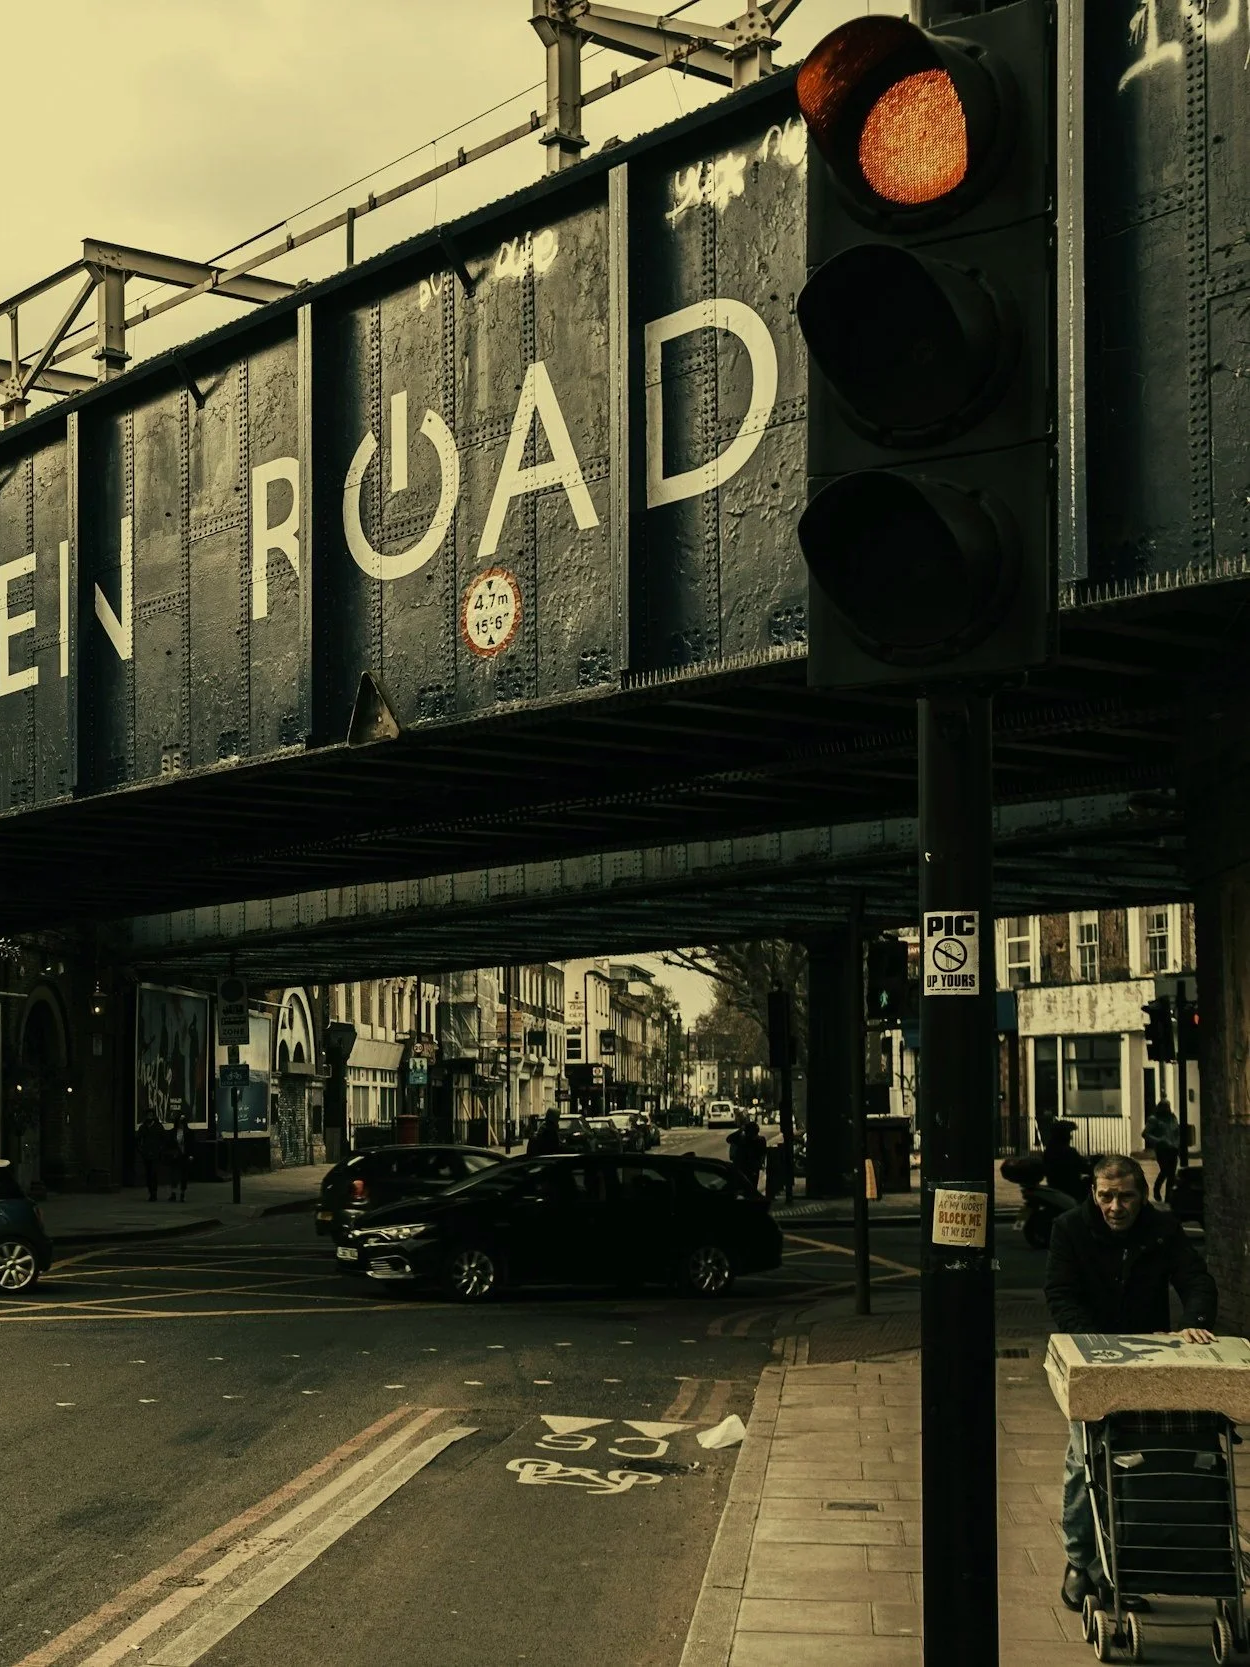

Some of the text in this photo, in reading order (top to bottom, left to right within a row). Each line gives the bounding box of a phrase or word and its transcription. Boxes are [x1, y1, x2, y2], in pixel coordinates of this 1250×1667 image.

[474, 593, 509, 610] 4.7m
[927, 915, 975, 937] PIC
[926, 974, 976, 987] UP YOURS
[939, 1210, 982, 1227] BLOCK ME
[961, 1227, 976, 1238] BEST
